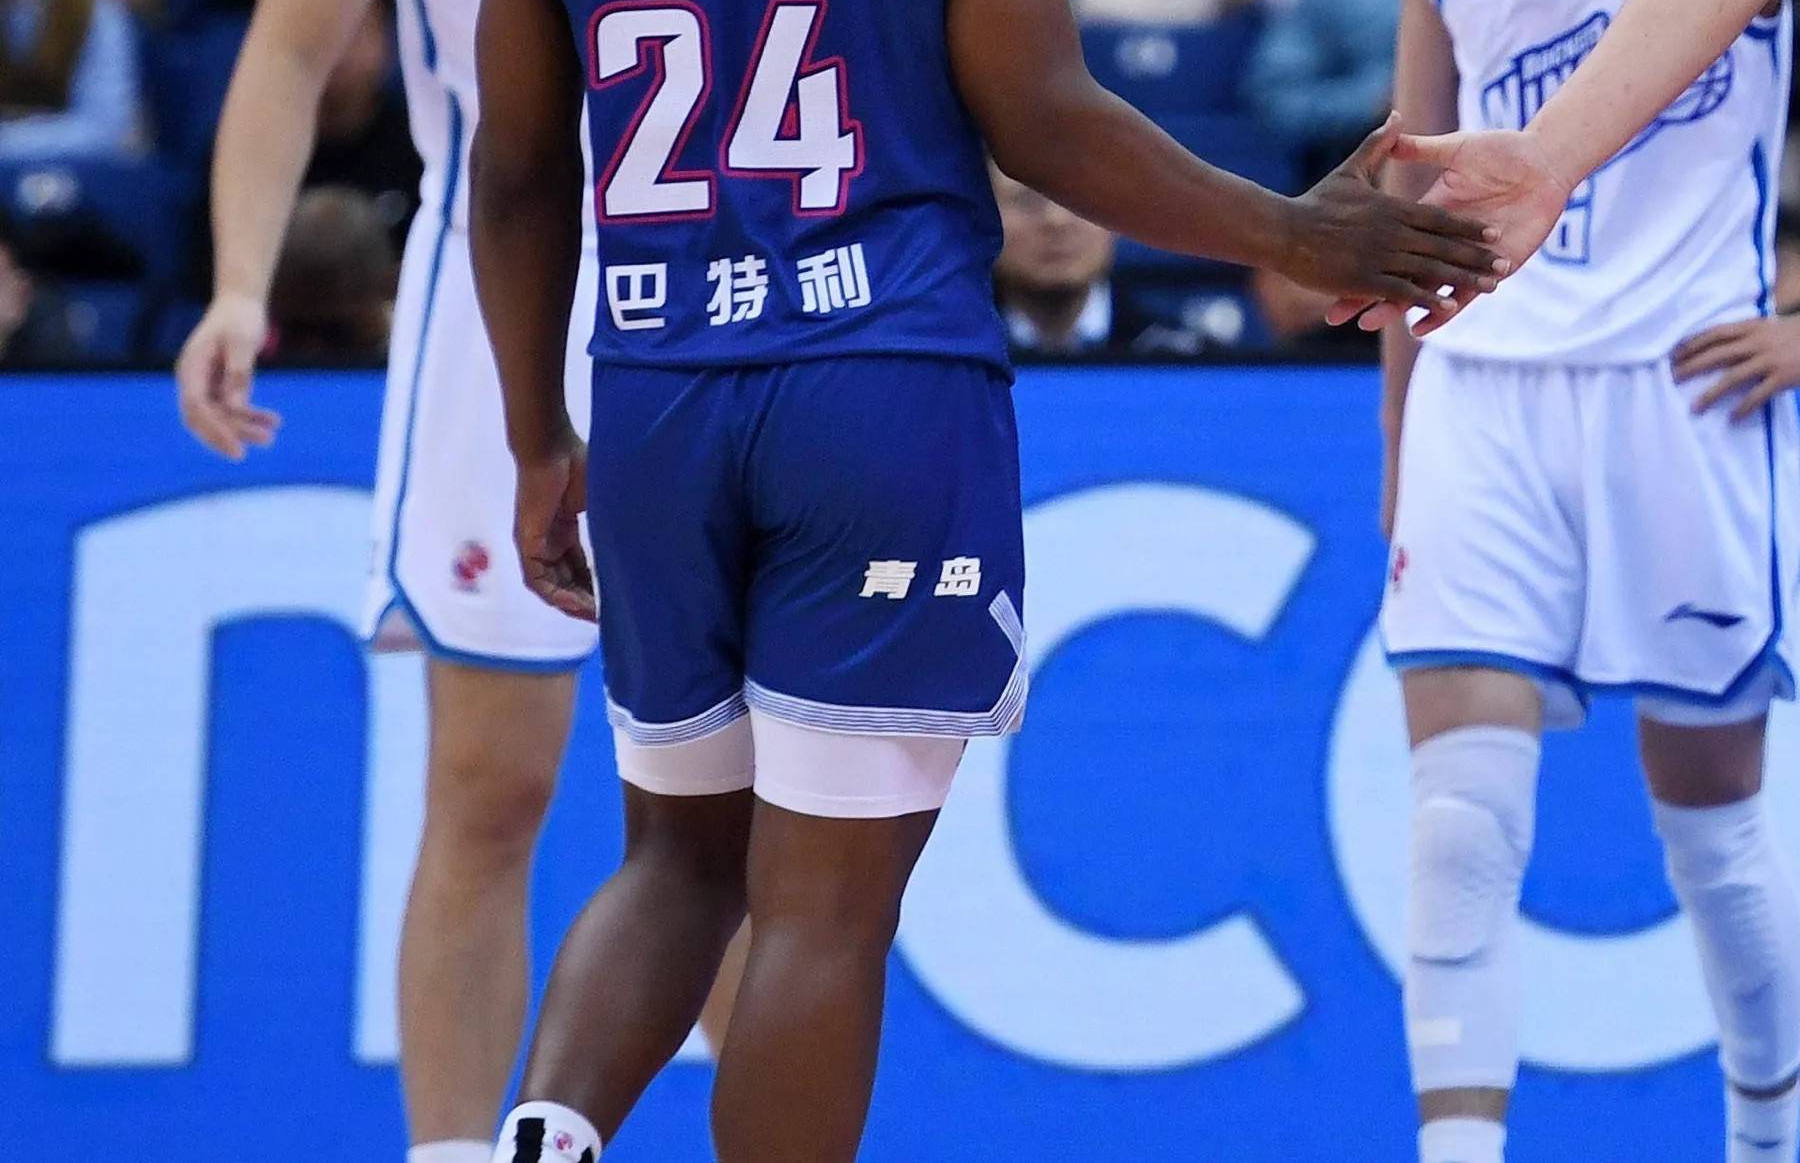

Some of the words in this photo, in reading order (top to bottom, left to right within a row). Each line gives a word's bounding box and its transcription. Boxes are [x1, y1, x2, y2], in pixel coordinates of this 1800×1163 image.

[606, 242, 873, 331] 巴特利
[858, 555, 982, 600] 青岛
